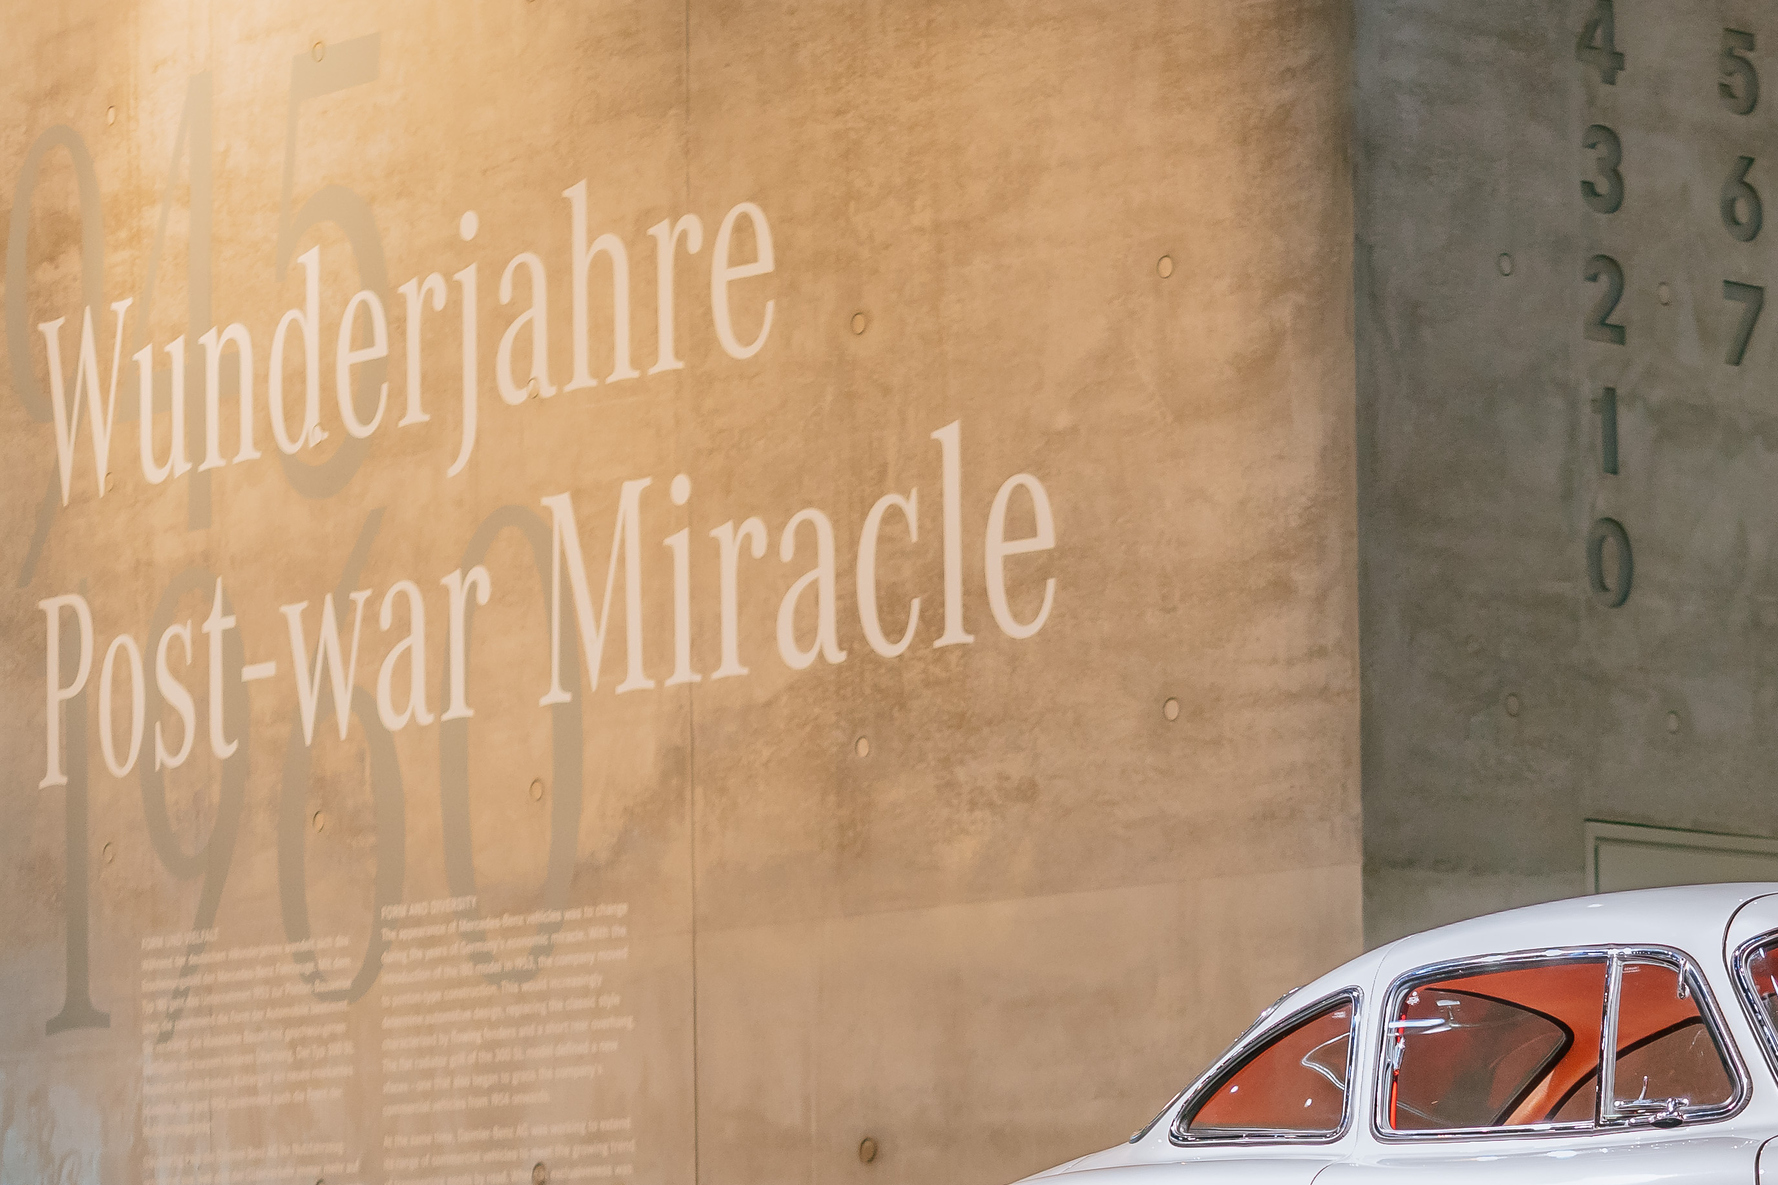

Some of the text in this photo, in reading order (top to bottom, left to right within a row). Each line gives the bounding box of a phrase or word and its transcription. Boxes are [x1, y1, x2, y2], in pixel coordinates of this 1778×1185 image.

[37, 179, 777, 507] Wunderjahre
[1574, 0, 1634, 609] 4 3 2 1 0
[1718, 27, 1764, 367] 5 6 7
[38, 419, 1057, 790] Post-war Miracle
